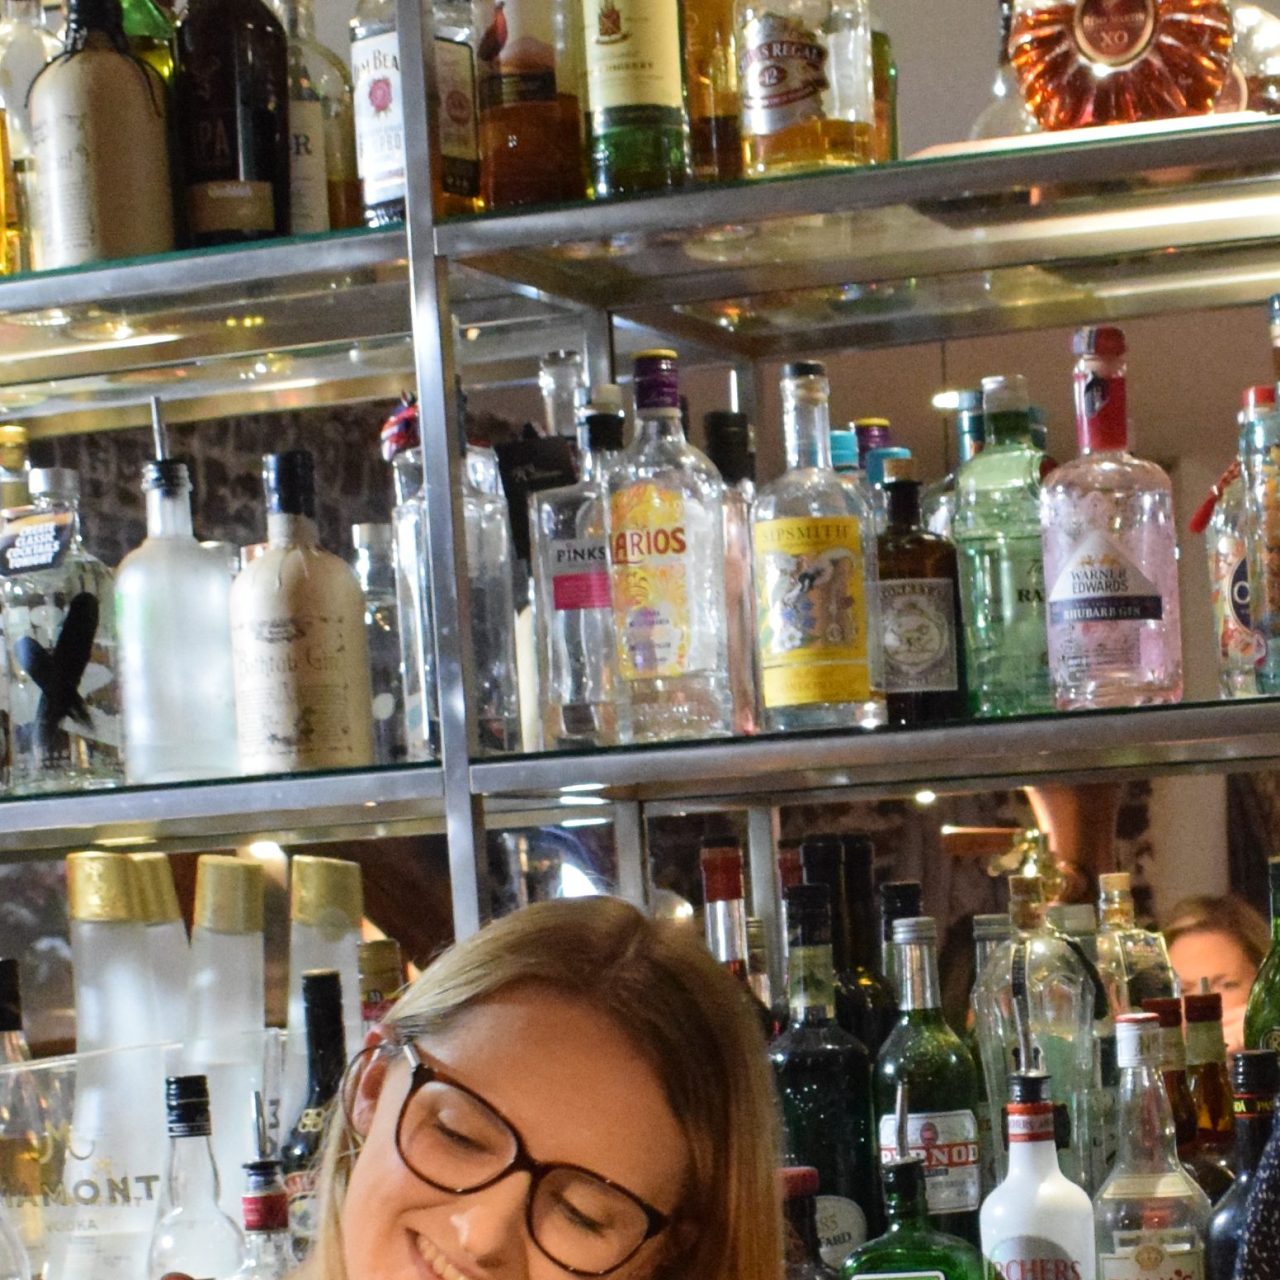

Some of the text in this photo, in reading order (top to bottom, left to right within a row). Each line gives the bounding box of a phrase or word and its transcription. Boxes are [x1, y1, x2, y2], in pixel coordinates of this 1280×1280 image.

[1100, 31, 1129, 48] XO
[6, 540, 60, 559] COCKTAILS
[1072, 568, 1127, 580] WARNER
[1072, 580, 1129, 594] EDWARDS
[1064, 607, 1117, 620] RHUBARB
[881, 1144, 979, 1167] PRNOD
